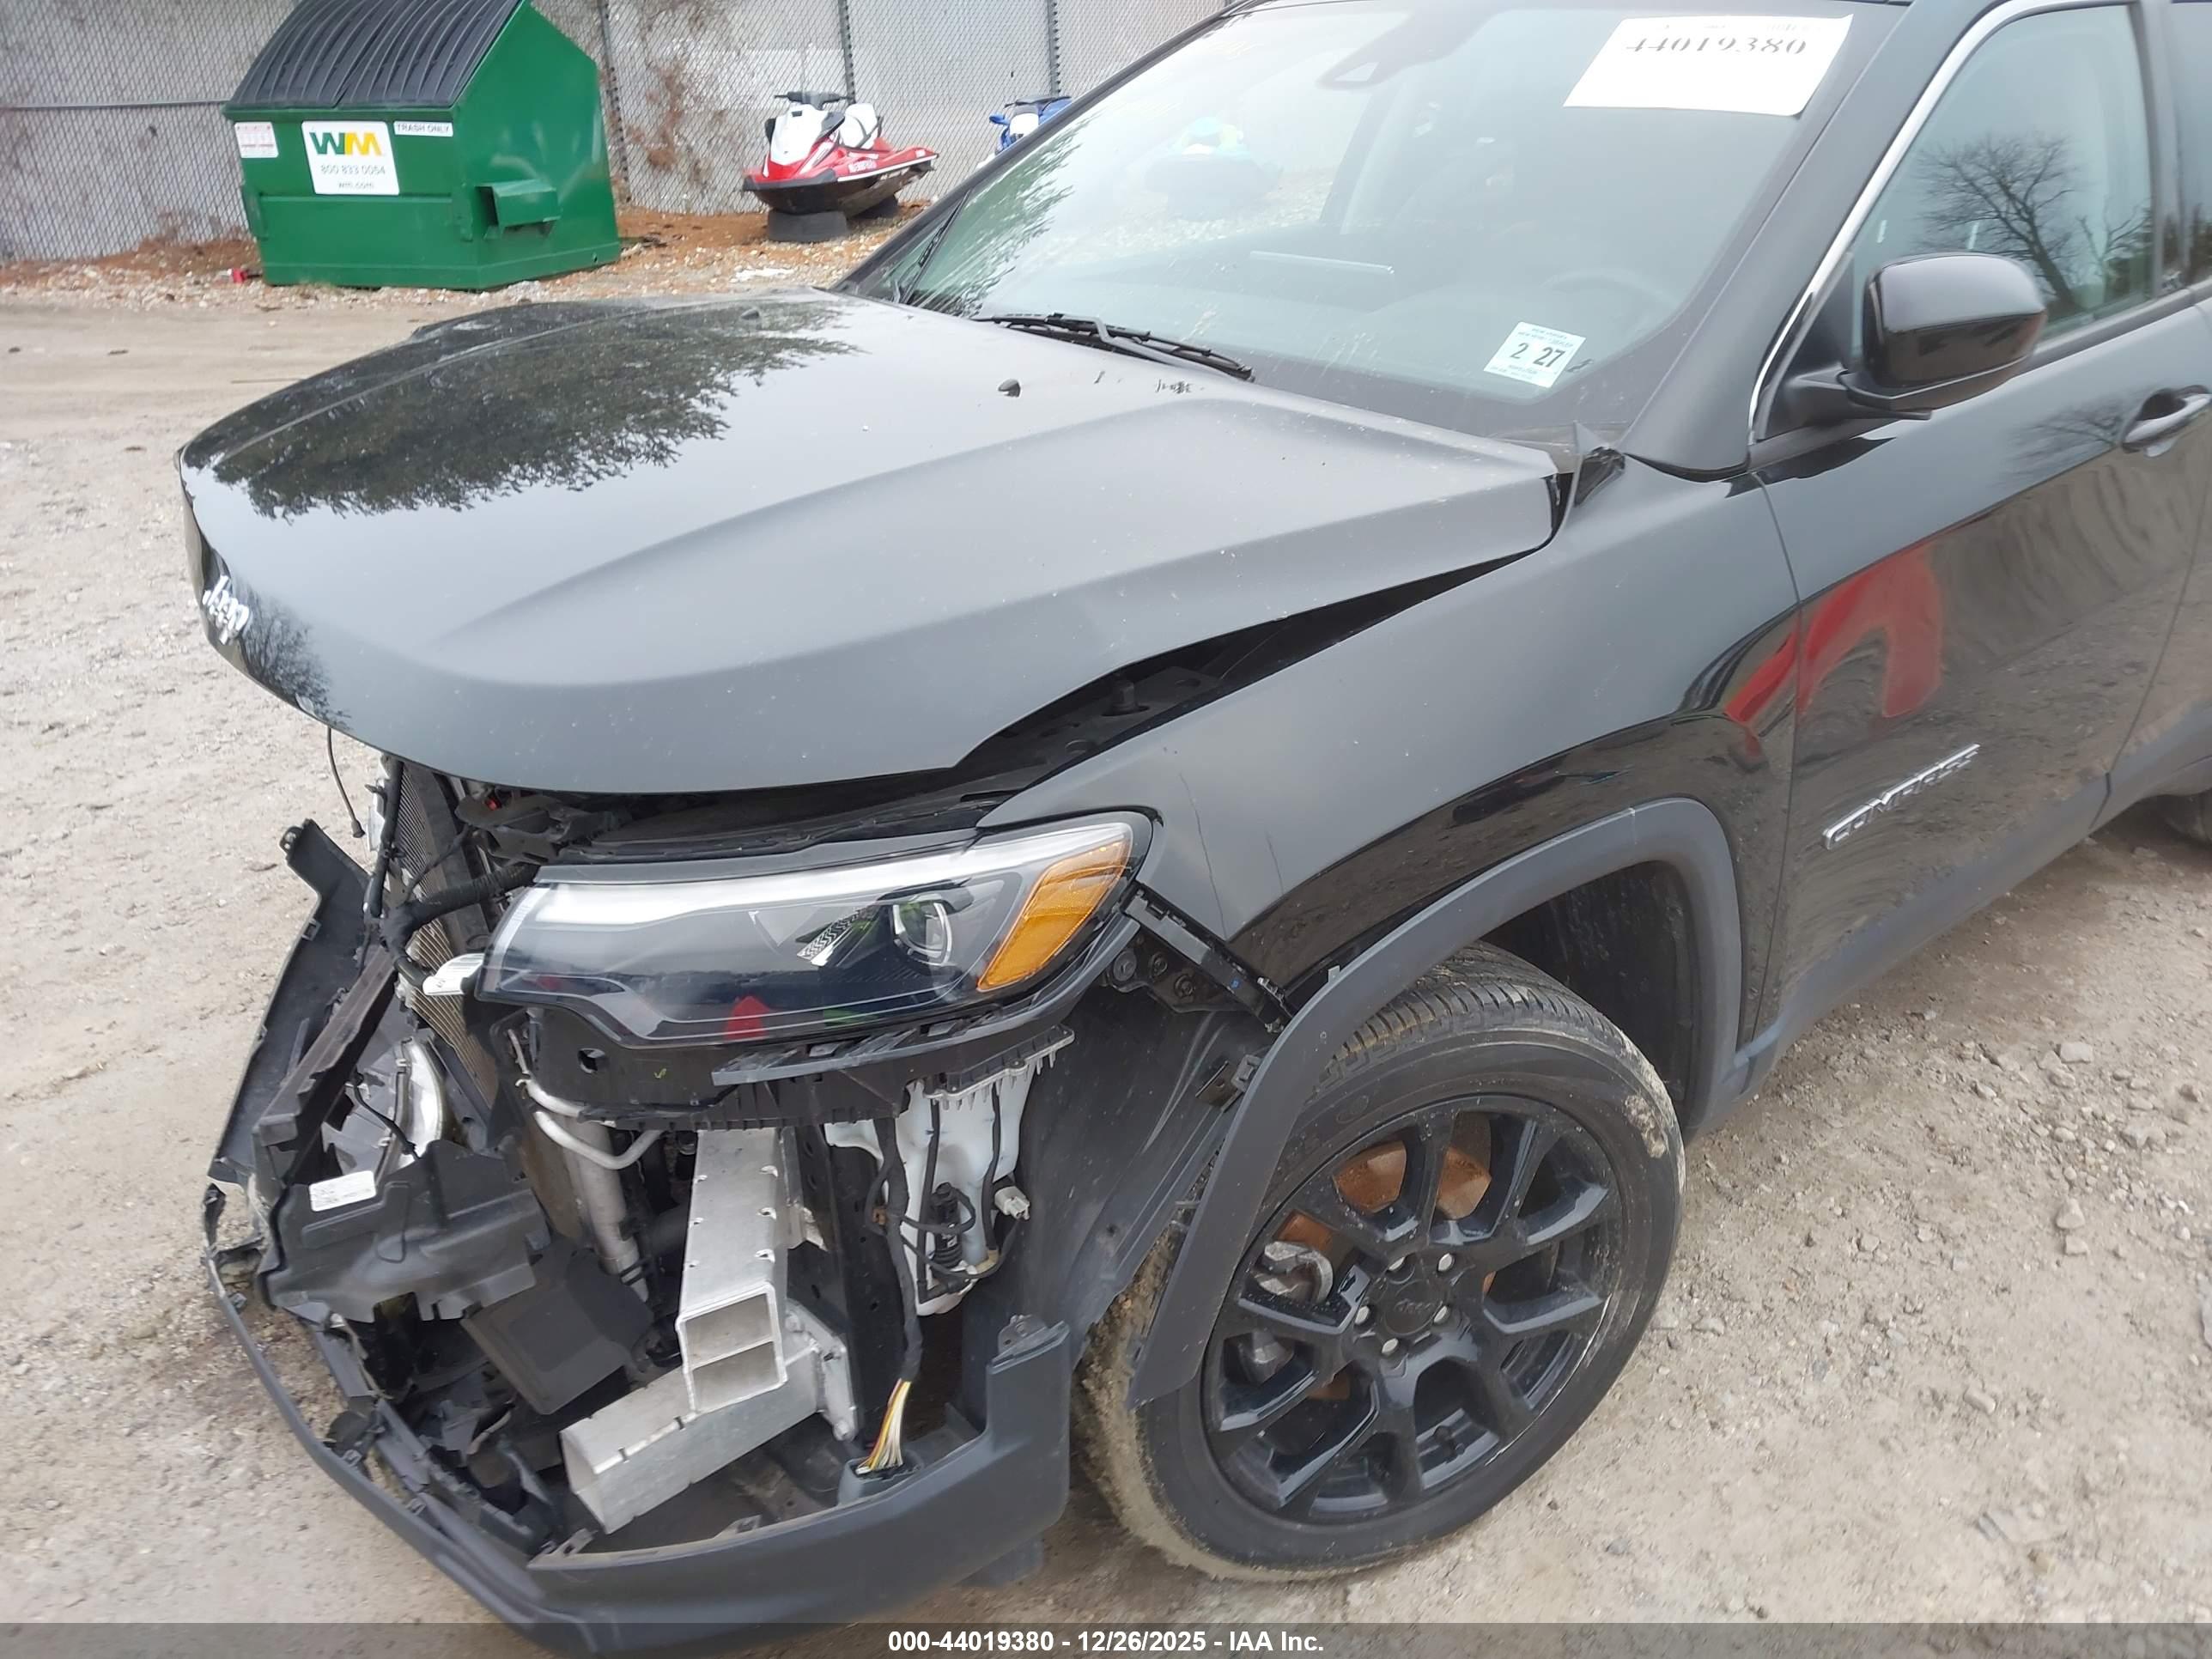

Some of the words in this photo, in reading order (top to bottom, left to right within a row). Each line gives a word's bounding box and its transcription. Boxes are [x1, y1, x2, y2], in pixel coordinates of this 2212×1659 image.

[1625, 36, 1808, 55] 44019380
[397, 122, 425, 131] TRASH
[428, 123, 450, 133] ONLY
[309, 131, 383, 156] WM
[320, 164, 339, 175] 800
[1510, 342, 1529, 360] 2
[1533, 346, 1565, 368] 27
